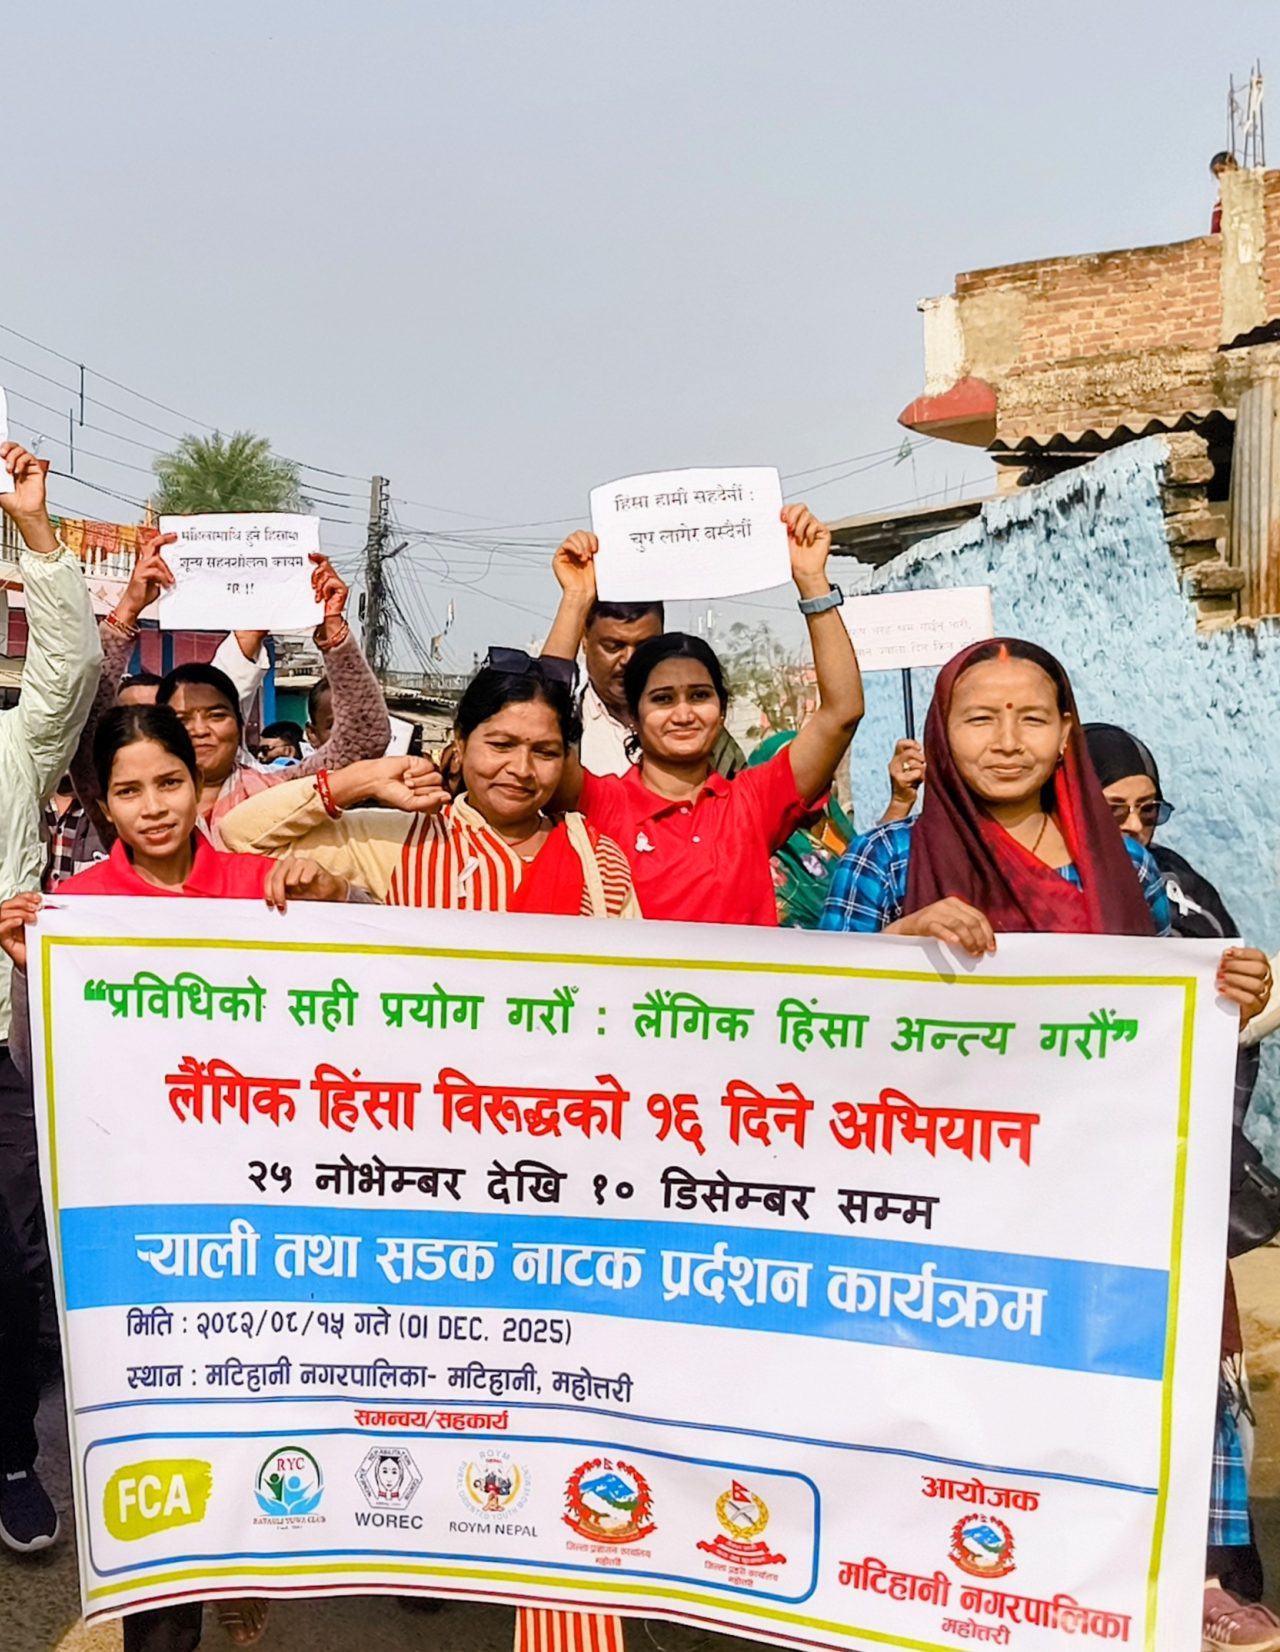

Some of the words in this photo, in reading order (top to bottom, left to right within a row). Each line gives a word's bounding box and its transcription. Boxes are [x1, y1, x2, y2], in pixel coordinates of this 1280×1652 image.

[287, 977, 359, 1033] सही
[379, 981, 485, 1029] प्रयोग
[632, 988, 756, 1042] लैंगिक
[776, 996, 871, 1053] हिंसा
[890, 1015, 1017, 1057] अन्त्य
[164, 1055, 301, 1127] लैंगिक
[310, 1062, 422, 1133] हिंसा
[646, 1092, 707, 1157] १६
[720, 1078, 816, 1150] दिने
[828, 1087, 1041, 1168] अभियान
[247, 1159, 293, 1193] २५
[314, 1152, 467, 1201] नोभेम्बर
[486, 1158, 568, 1205] देखि
[592, 1173, 635, 1206] १०
[659, 1165, 816, 1221] डिसेम्बर
[837, 1188, 941, 1231] सम्म
[273, 1232, 363, 1280] तथा
[375, 1236, 499, 1285] सडक
[511, 1241, 647, 1291] नाटक
[826, 1260, 1050, 1337] कार्यक्रम
[126, 1305, 174, 1337] मिति
[354, 1305, 392, 1337] गते
[438, 1315, 489, 1342] DEC.
[502, 1316, 573, 1346] 2025)
[126, 1364, 184, 1389] स्थान
[204, 1355, 293, 1393] मटिहानी
[447, 1360, 542, 1396] मटिहानी,
[552, 1366, 634, 1403] महोत्तरी
[276, 1456, 305, 1472] RYC
[118, 1472, 193, 1524] FCA
[920, 1475, 1041, 1513] आयोजक
[354, 1511, 424, 1530] WOREC
[448, 1520, 491, 1534] ROYM
[494, 1523, 539, 1538] NEPAL
[837, 1556, 952, 1608] मटिहानी
[959, 1583, 1133, 1643] नगरपालिका
[940, 1616, 1012, 1646] महोत्तरी
